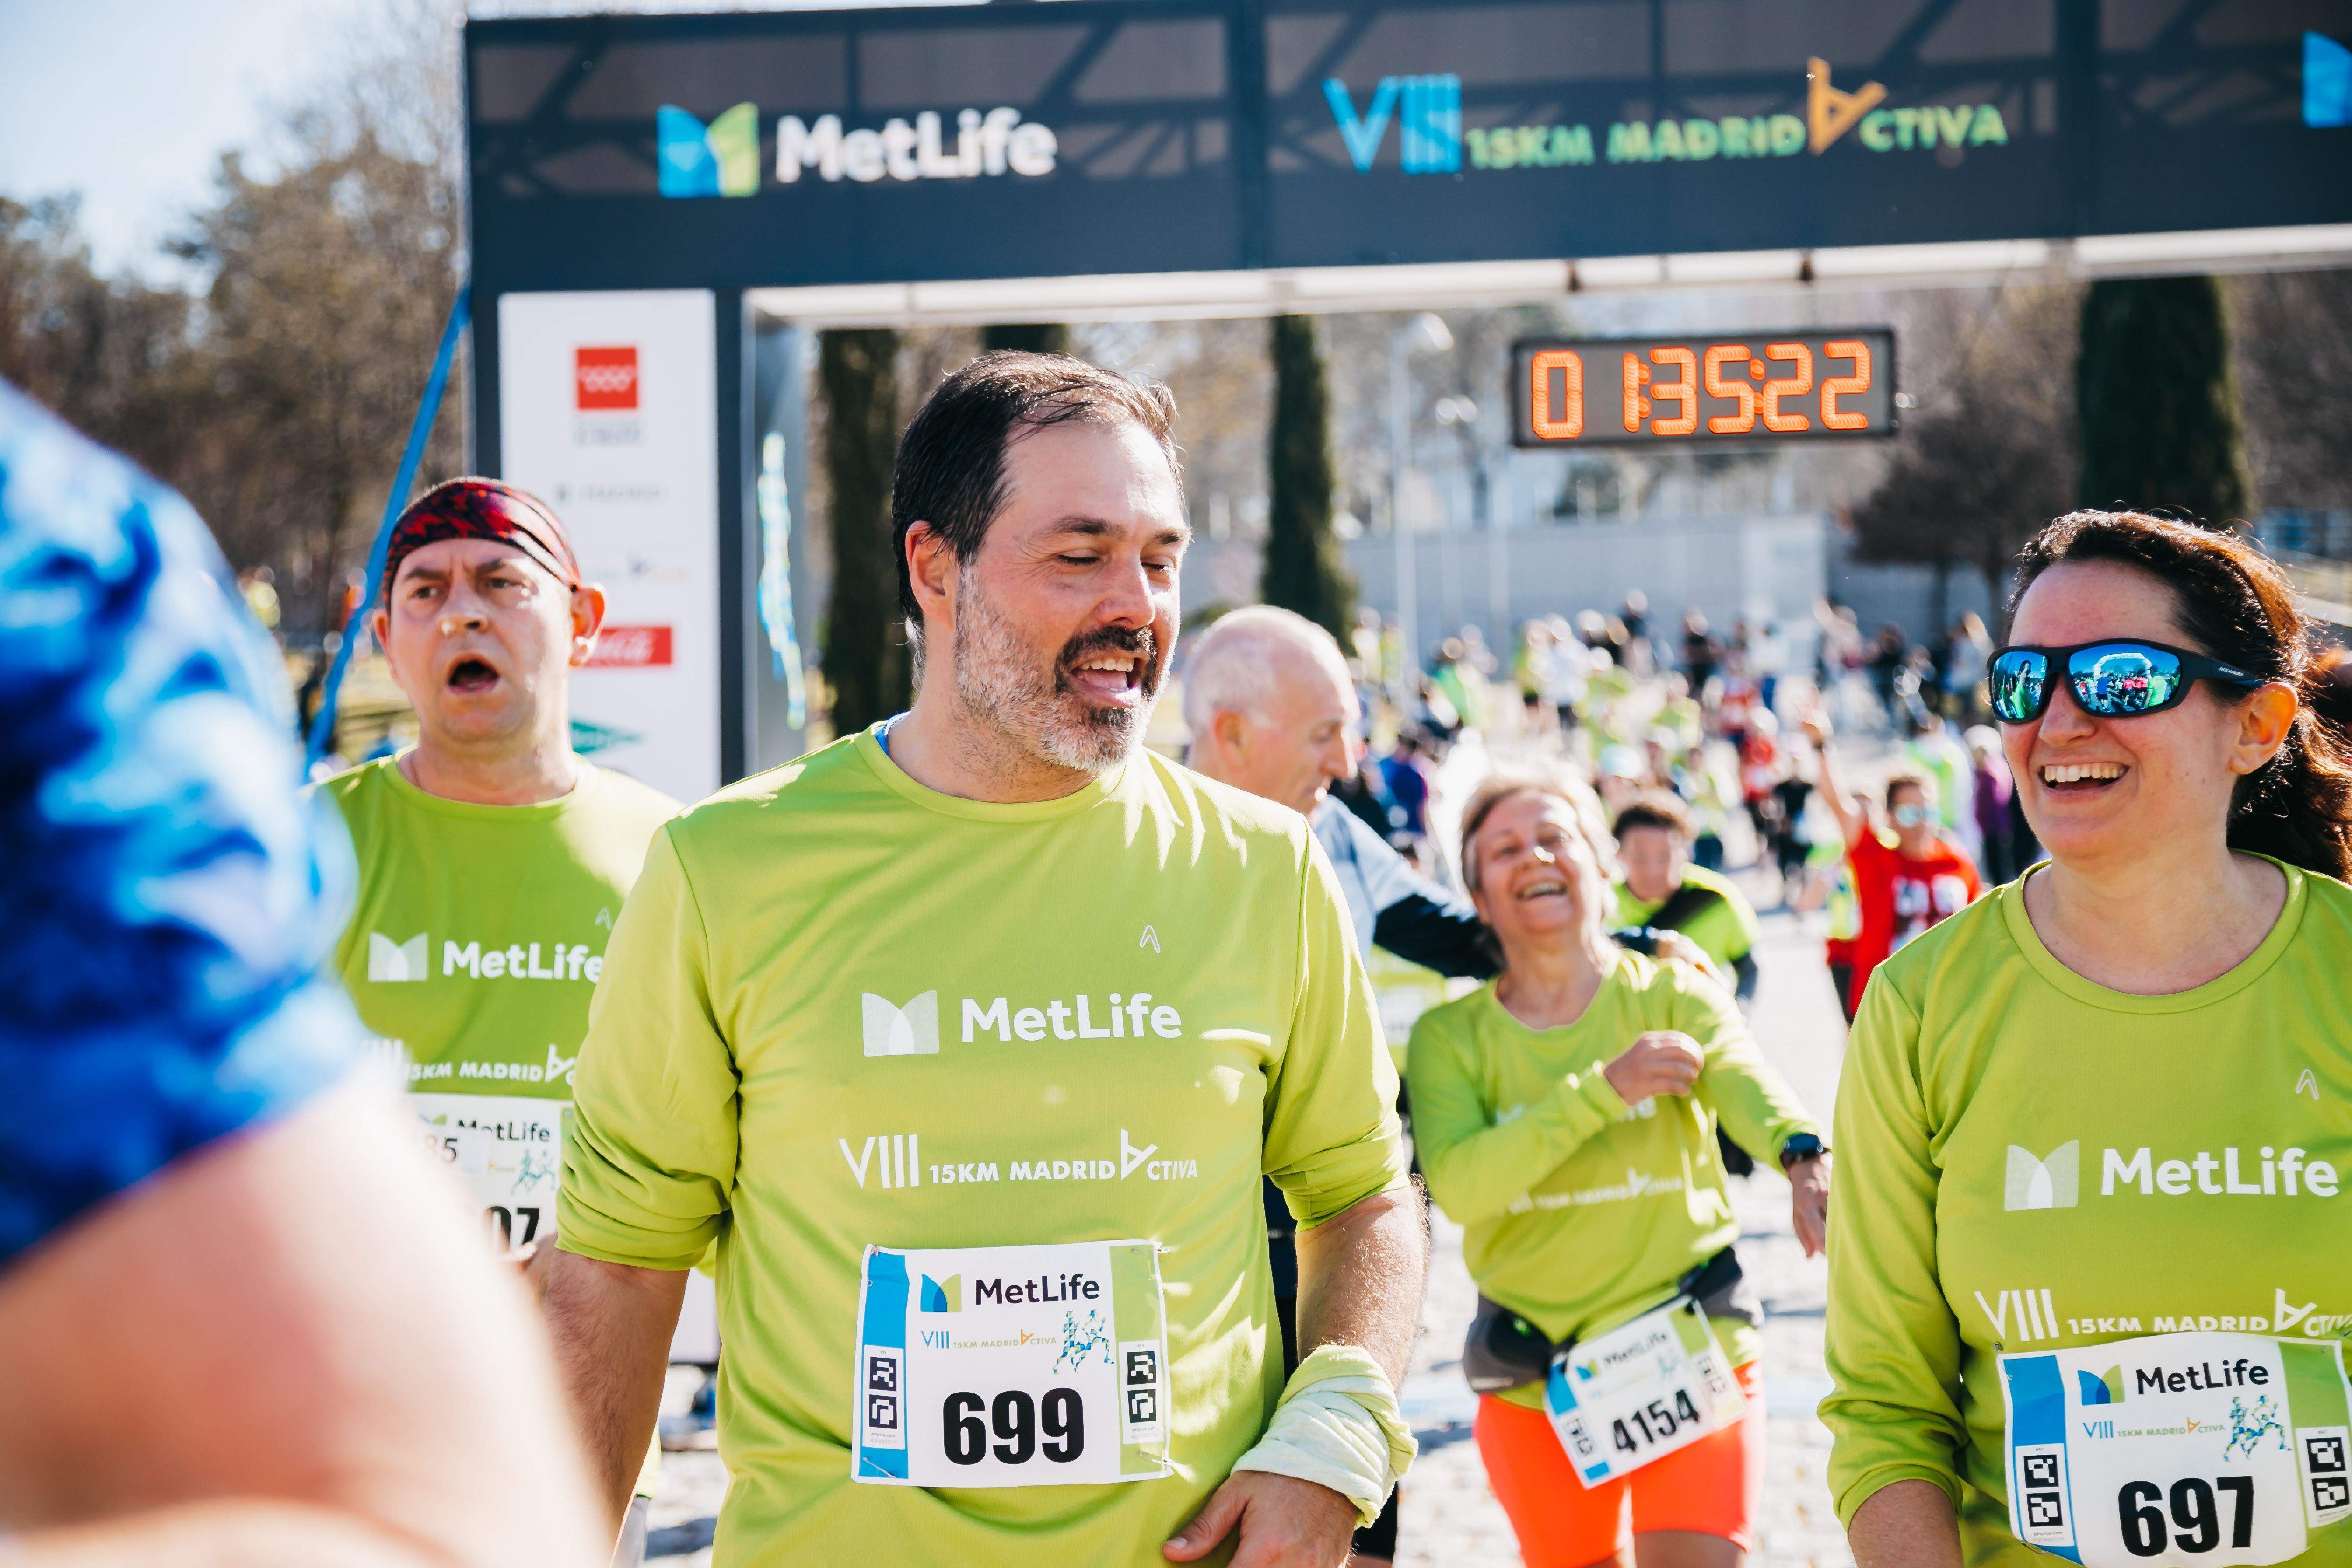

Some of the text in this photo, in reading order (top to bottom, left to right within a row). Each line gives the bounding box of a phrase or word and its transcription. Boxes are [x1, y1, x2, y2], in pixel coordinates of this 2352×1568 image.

[776, 106, 1058, 183] MetLife
[1321, 72, 1463, 175] VIII
[1465, 124, 1595, 170] 15KM
[1606, 114, 1807, 161] MADRID
[2219, 667, 2244, 676] ROCKRIDER
[443, 940, 606, 983] MetLife
[962, 992, 1182, 1042] MetLife
[458, 1061, 544, 1083] MADRID
[839, 1128, 1198, 1189] VIII 15KM MADRID ACTIVA
[2100, 1146, 2339, 1197] MetLife
[975, 1273, 1099, 1305] MetLife
[921, 1330, 949, 1349] VIII
[1020, 1329, 1057, 1346] ACTIVA
[1974, 1289, 2060, 1341] VIII
[2067, 1317, 2142, 1335] 15KM
[2153, 1316, 2270, 1332] MADRID
[2136, 1358, 2269, 1395] MetLife
[943, 1387, 1085, 1466] 699
[1612, 1389, 1700, 1452] 4154
[2083, 1416, 2226, 1439] VIII 15KM MADRID ACTIVA
[2118, 1476, 2254, 1557] 697
